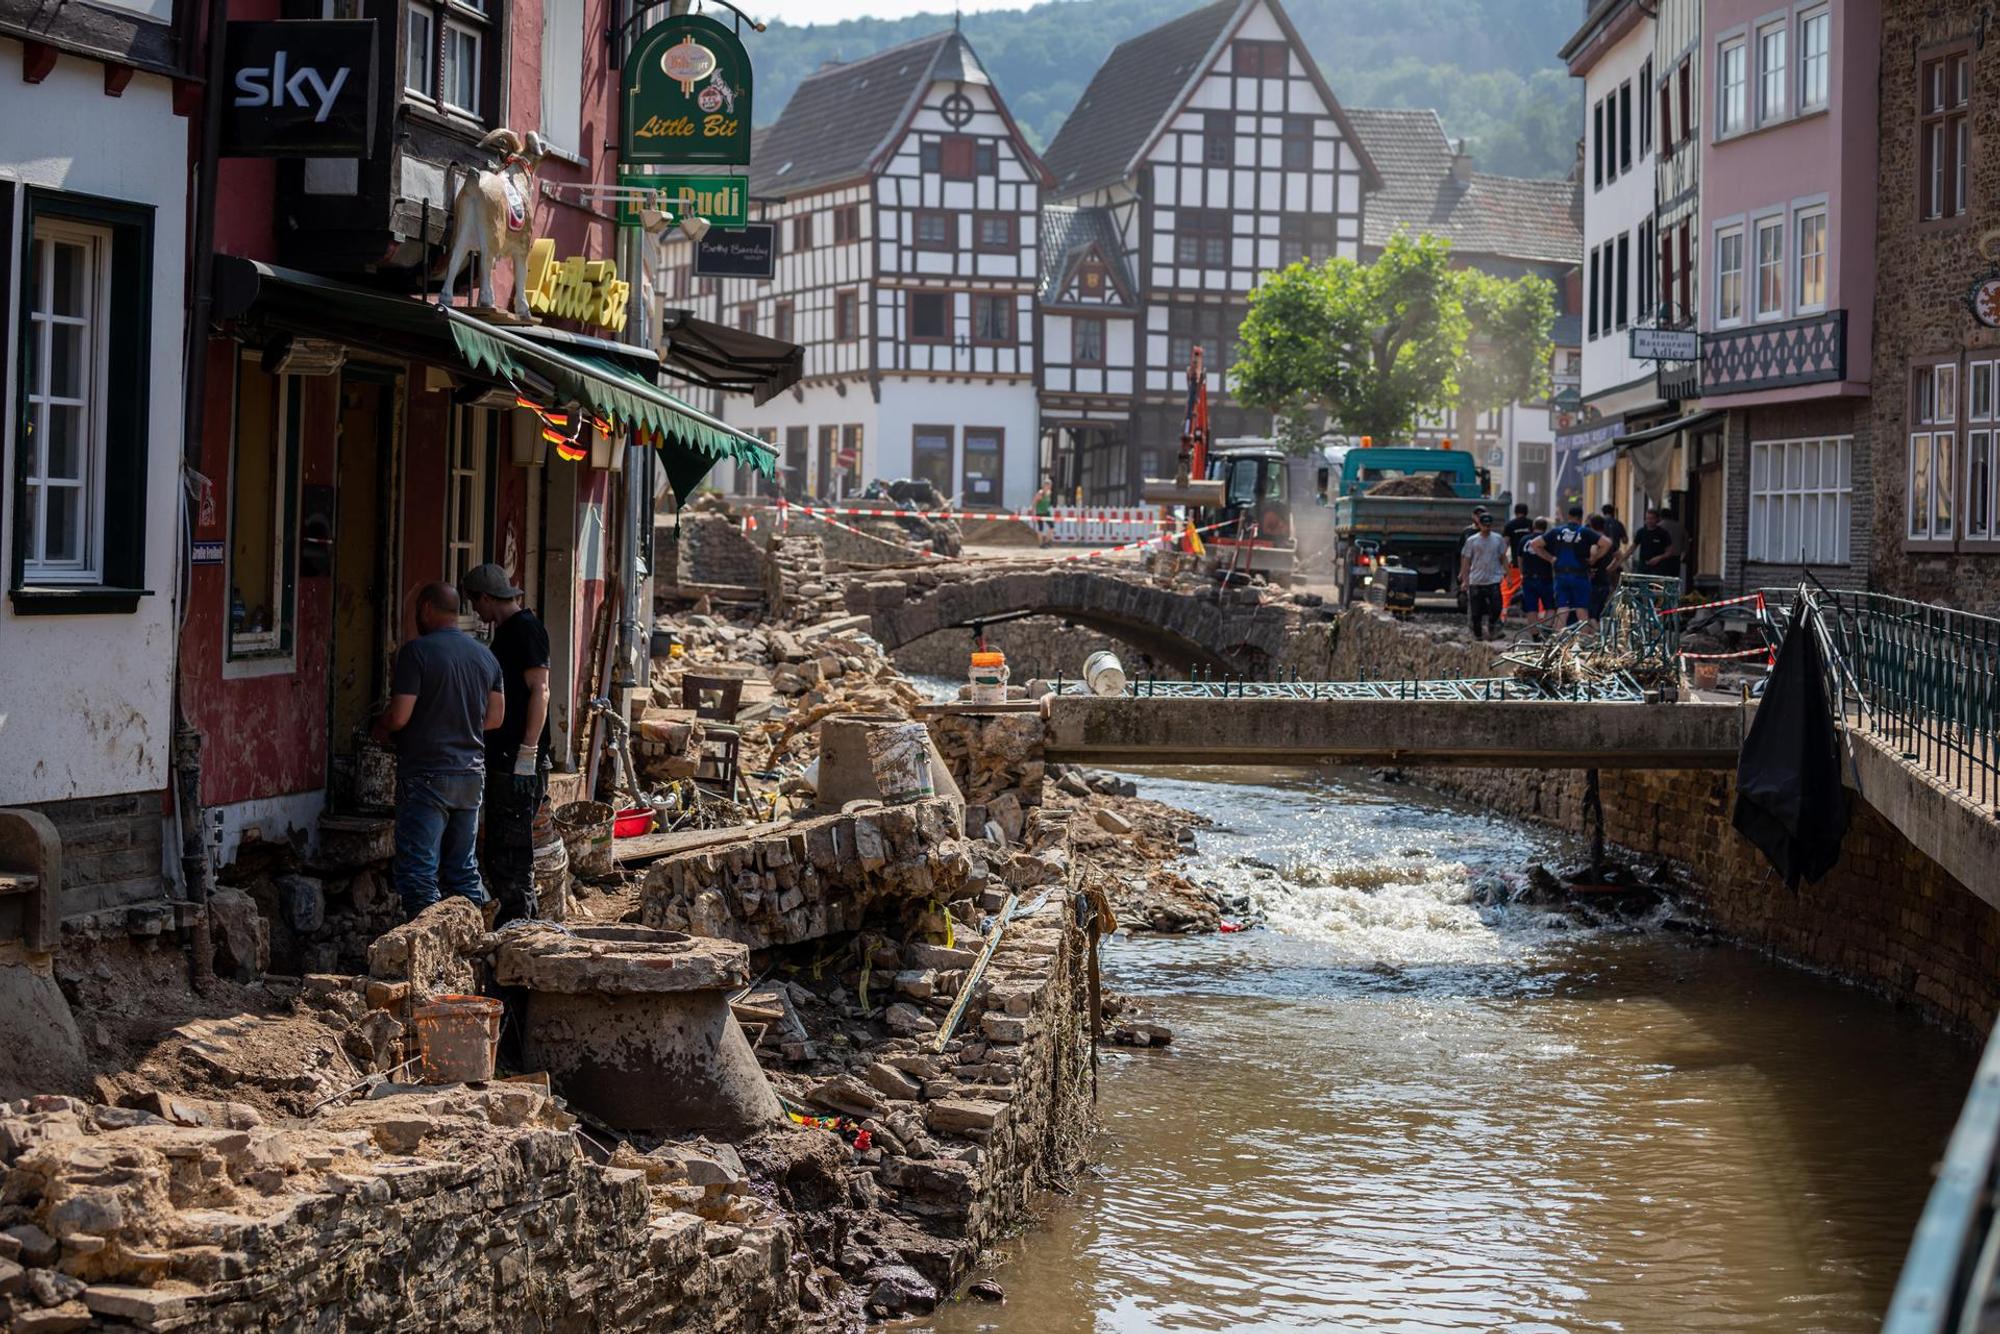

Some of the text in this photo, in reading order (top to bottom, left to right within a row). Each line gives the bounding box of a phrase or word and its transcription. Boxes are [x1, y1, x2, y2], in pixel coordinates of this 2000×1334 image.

[234, 50, 351, 122] sky
[634, 114, 737, 138] Little Bit
[1651, 347, 1685, 358] Adler
